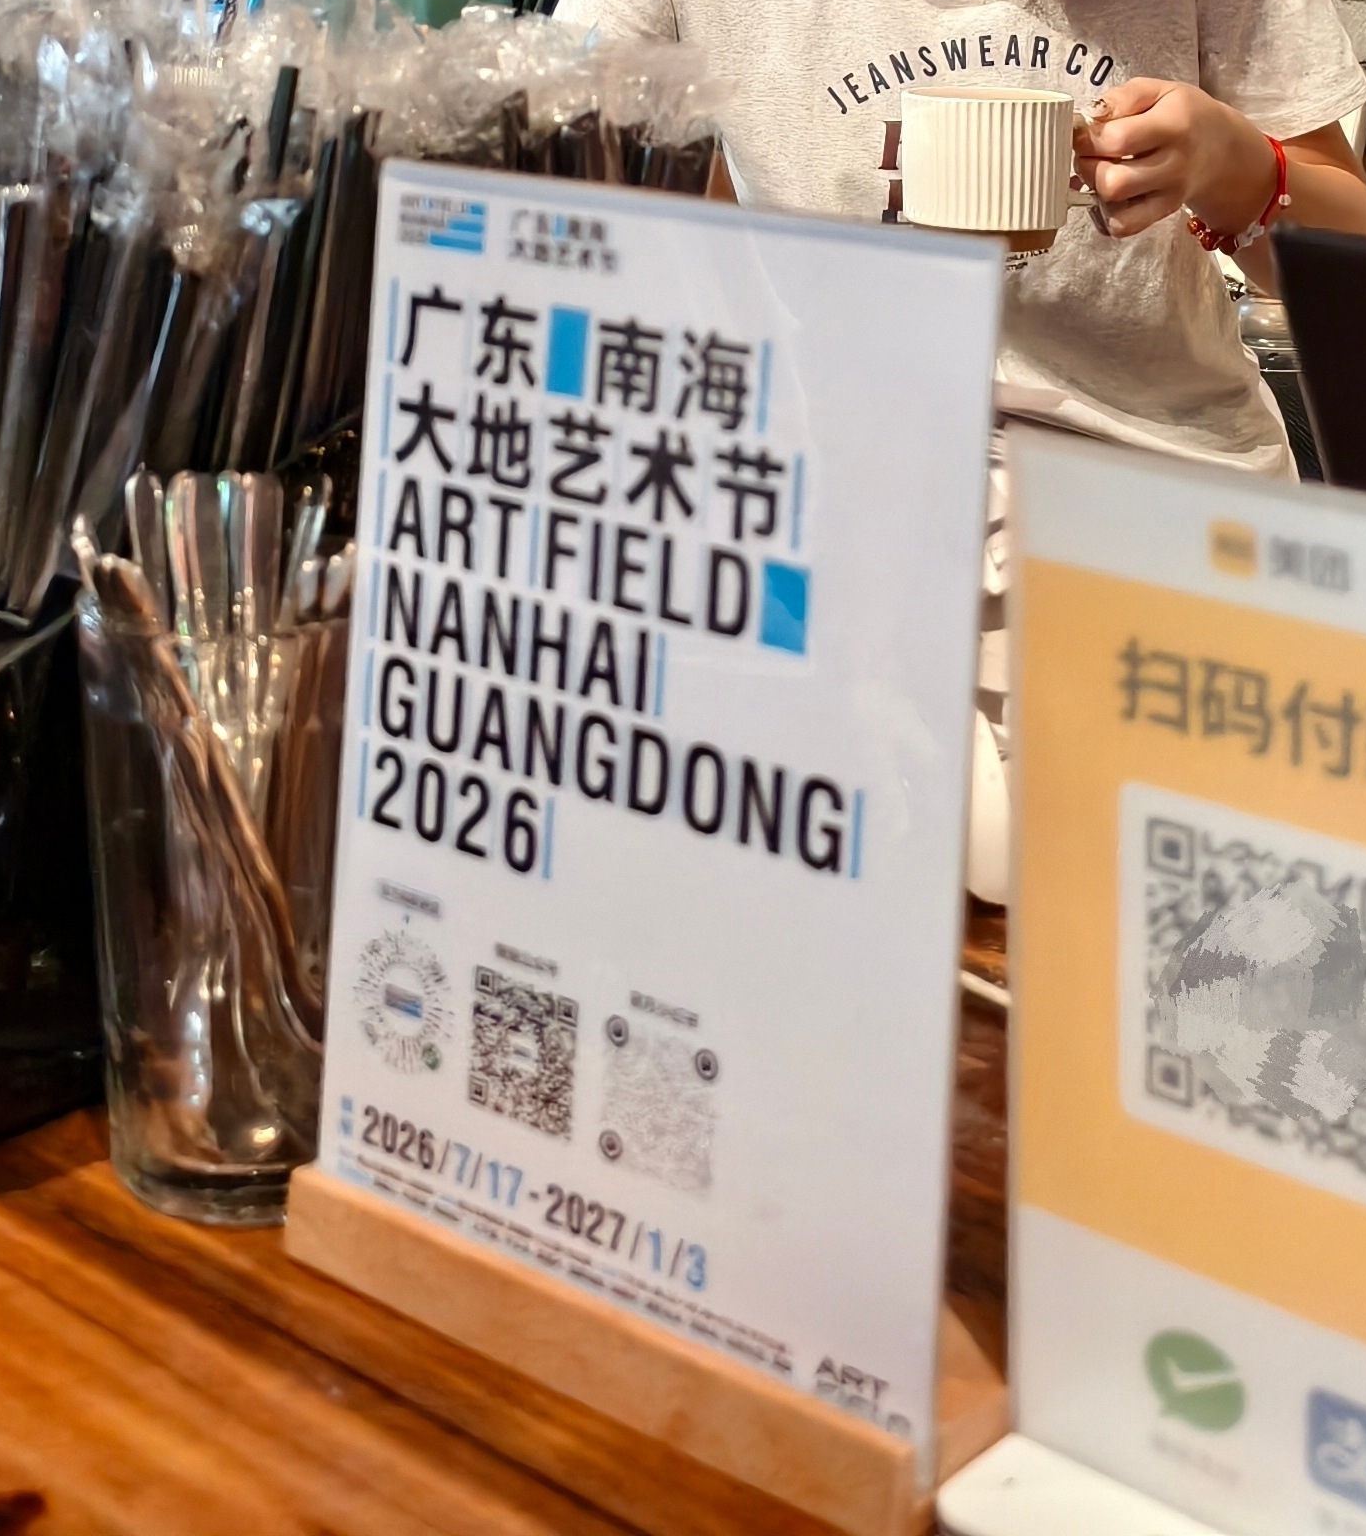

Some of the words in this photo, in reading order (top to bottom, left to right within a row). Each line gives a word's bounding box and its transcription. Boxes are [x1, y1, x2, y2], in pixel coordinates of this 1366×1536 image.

[826, 34, 1050, 115] JEANSWEAR
[1065, 42, 1115, 87] CO
[395, 382, 785, 541] 大地艺术节
[389, 478, 524, 579] ART
[543, 507, 754, 641] FIELD
[382, 566, 651, 714] NANHAI
[371, 749, 539, 874] 2026
[378, 655, 844, 873] GUANGDONG
